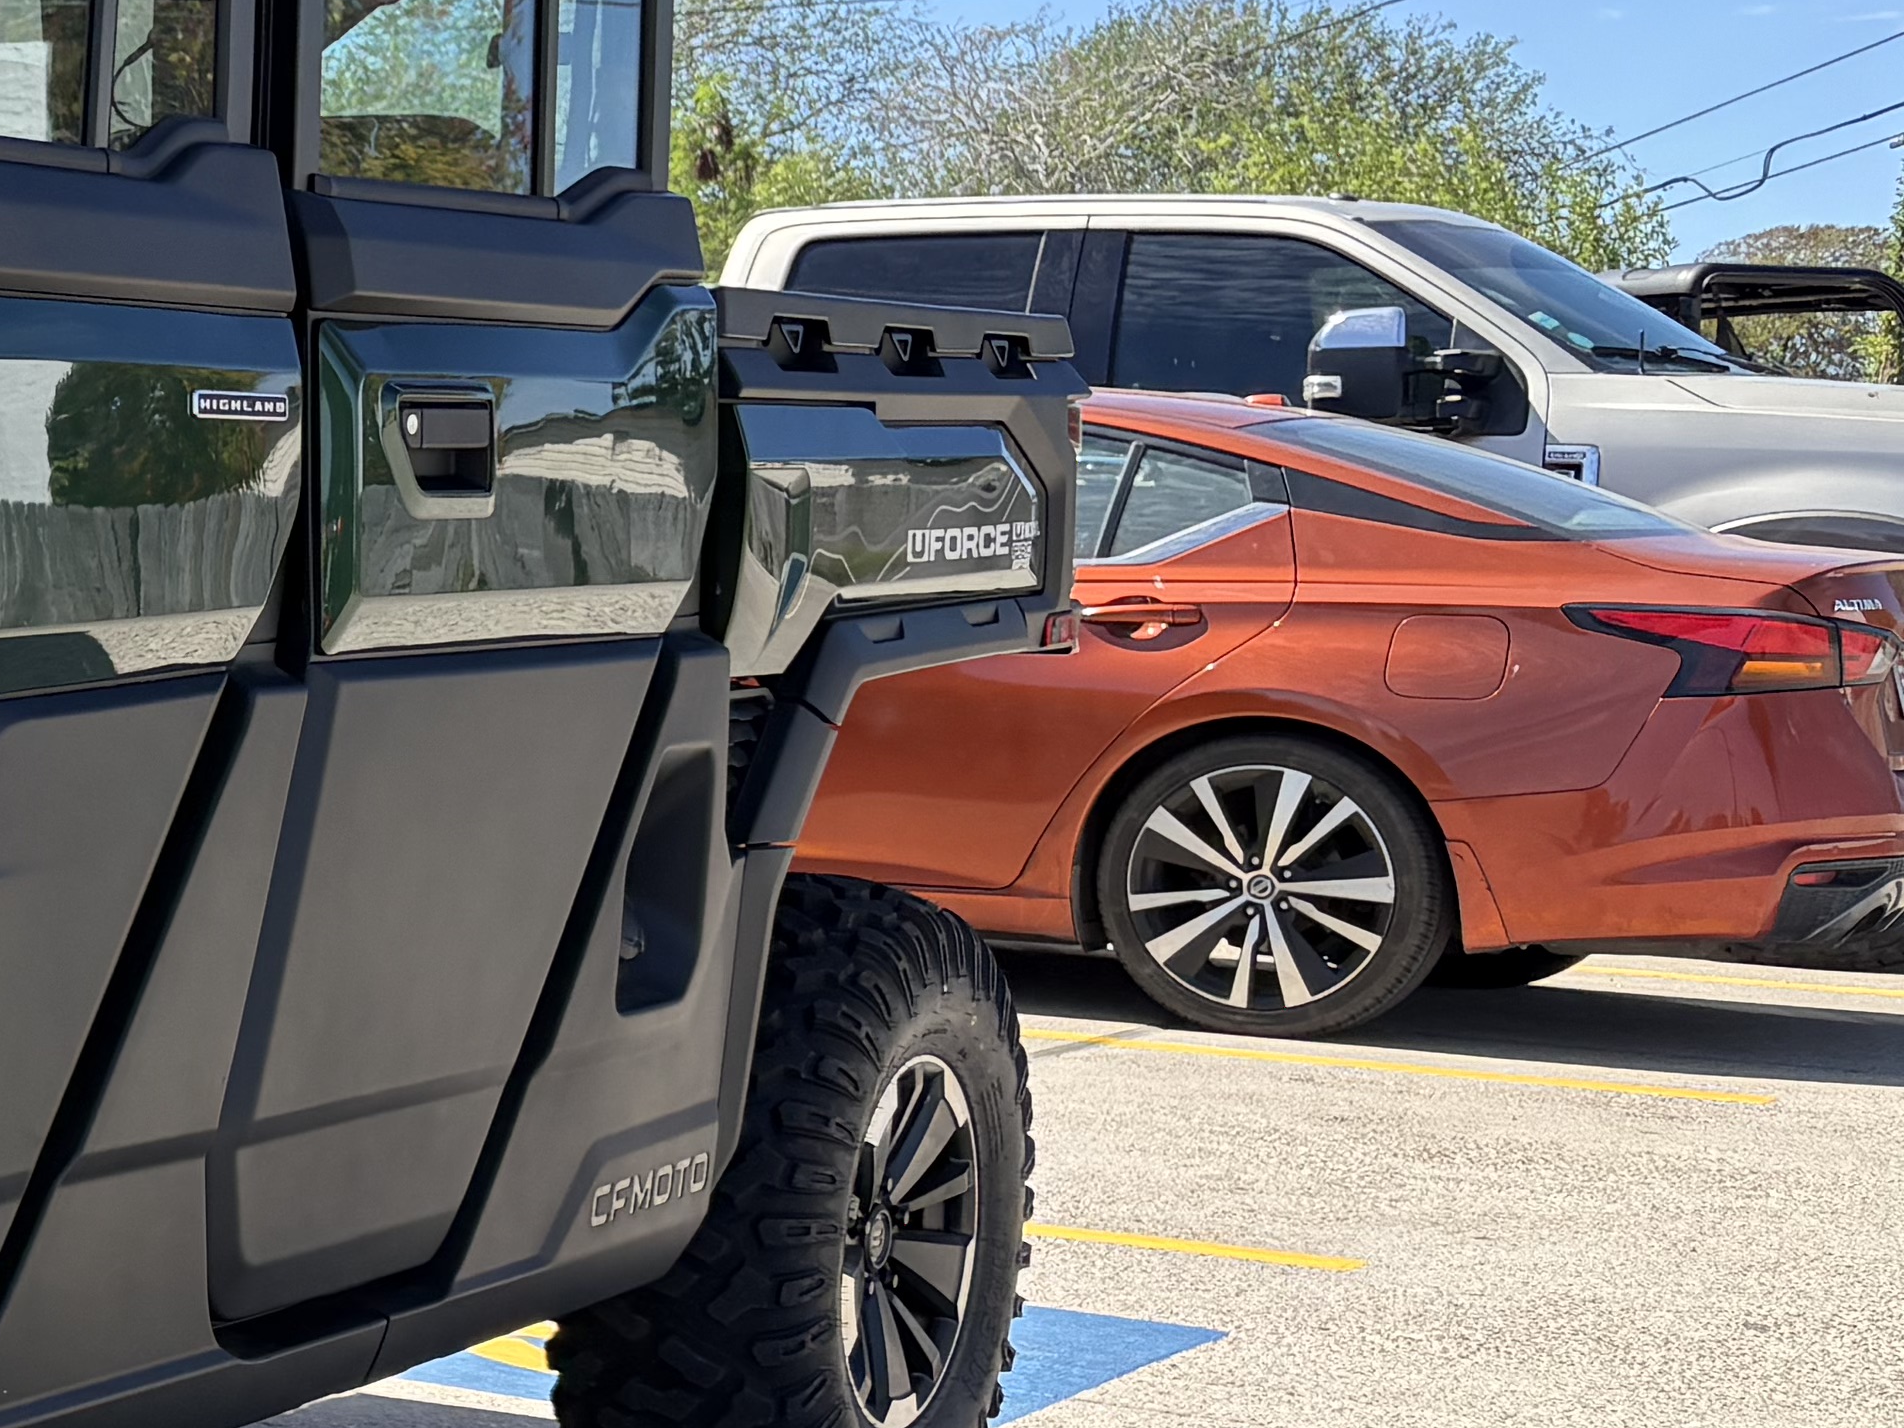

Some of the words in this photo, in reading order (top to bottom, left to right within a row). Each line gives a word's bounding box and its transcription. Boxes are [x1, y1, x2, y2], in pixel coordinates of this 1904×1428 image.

[199, 398, 285, 413] HIGHLAND
[907, 523, 1011, 563] UFORCE
[1834, 598, 1883, 612] ALTIMA
[590, 1152, 708, 1227] CFMOTO
